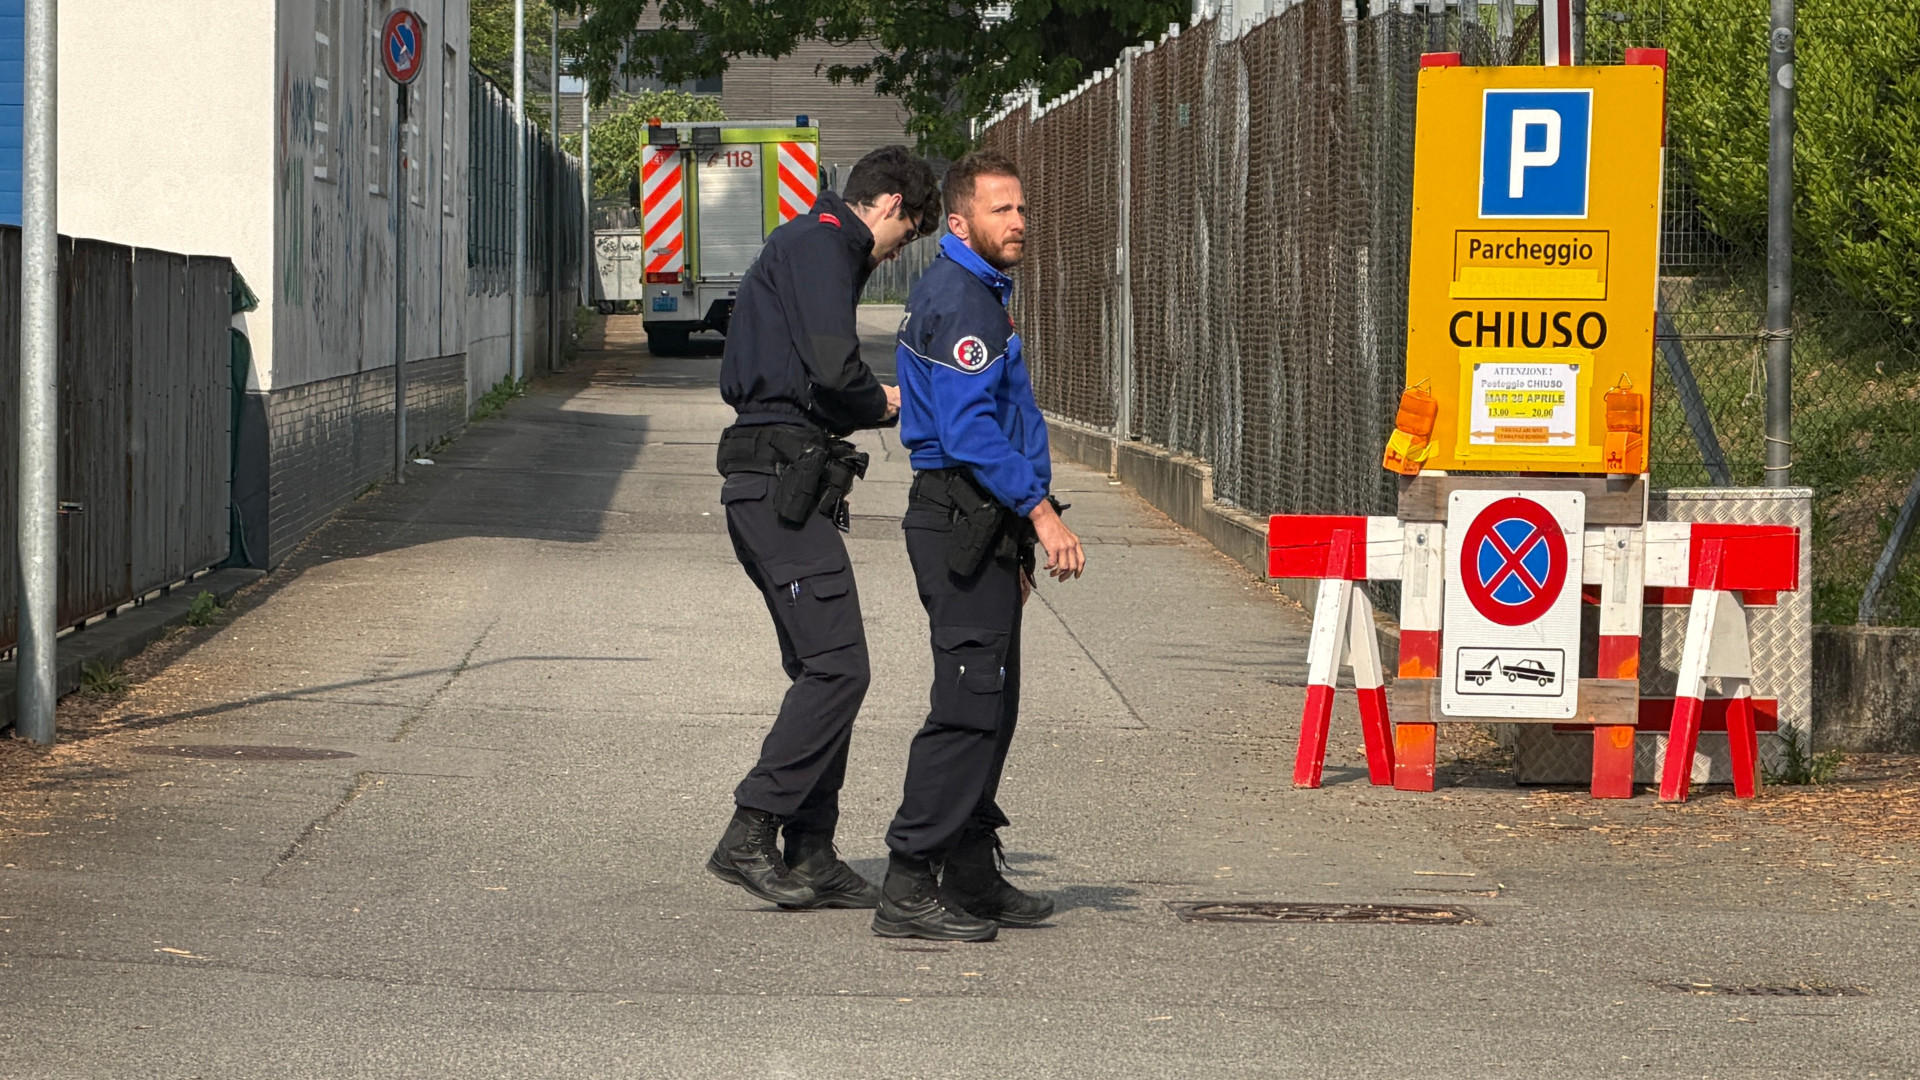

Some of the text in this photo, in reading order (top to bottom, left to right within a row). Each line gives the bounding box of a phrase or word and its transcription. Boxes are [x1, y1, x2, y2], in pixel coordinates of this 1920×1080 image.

[723, 150, 754, 168] 118
[1508, 109, 1562, 199] P
[1469, 237, 1593, 266] Parcheggio
[1449, 310, 1608, 350] CHIUSO
[1481, 379, 1563, 390] Posteggio CHIUSO
[1485, 393, 1508, 403] MAR
[1526, 394, 1565, 404] APRILE
[1488, 408, 1509, 417] 13.00
[1532, 408, 1554, 418] 20.00
